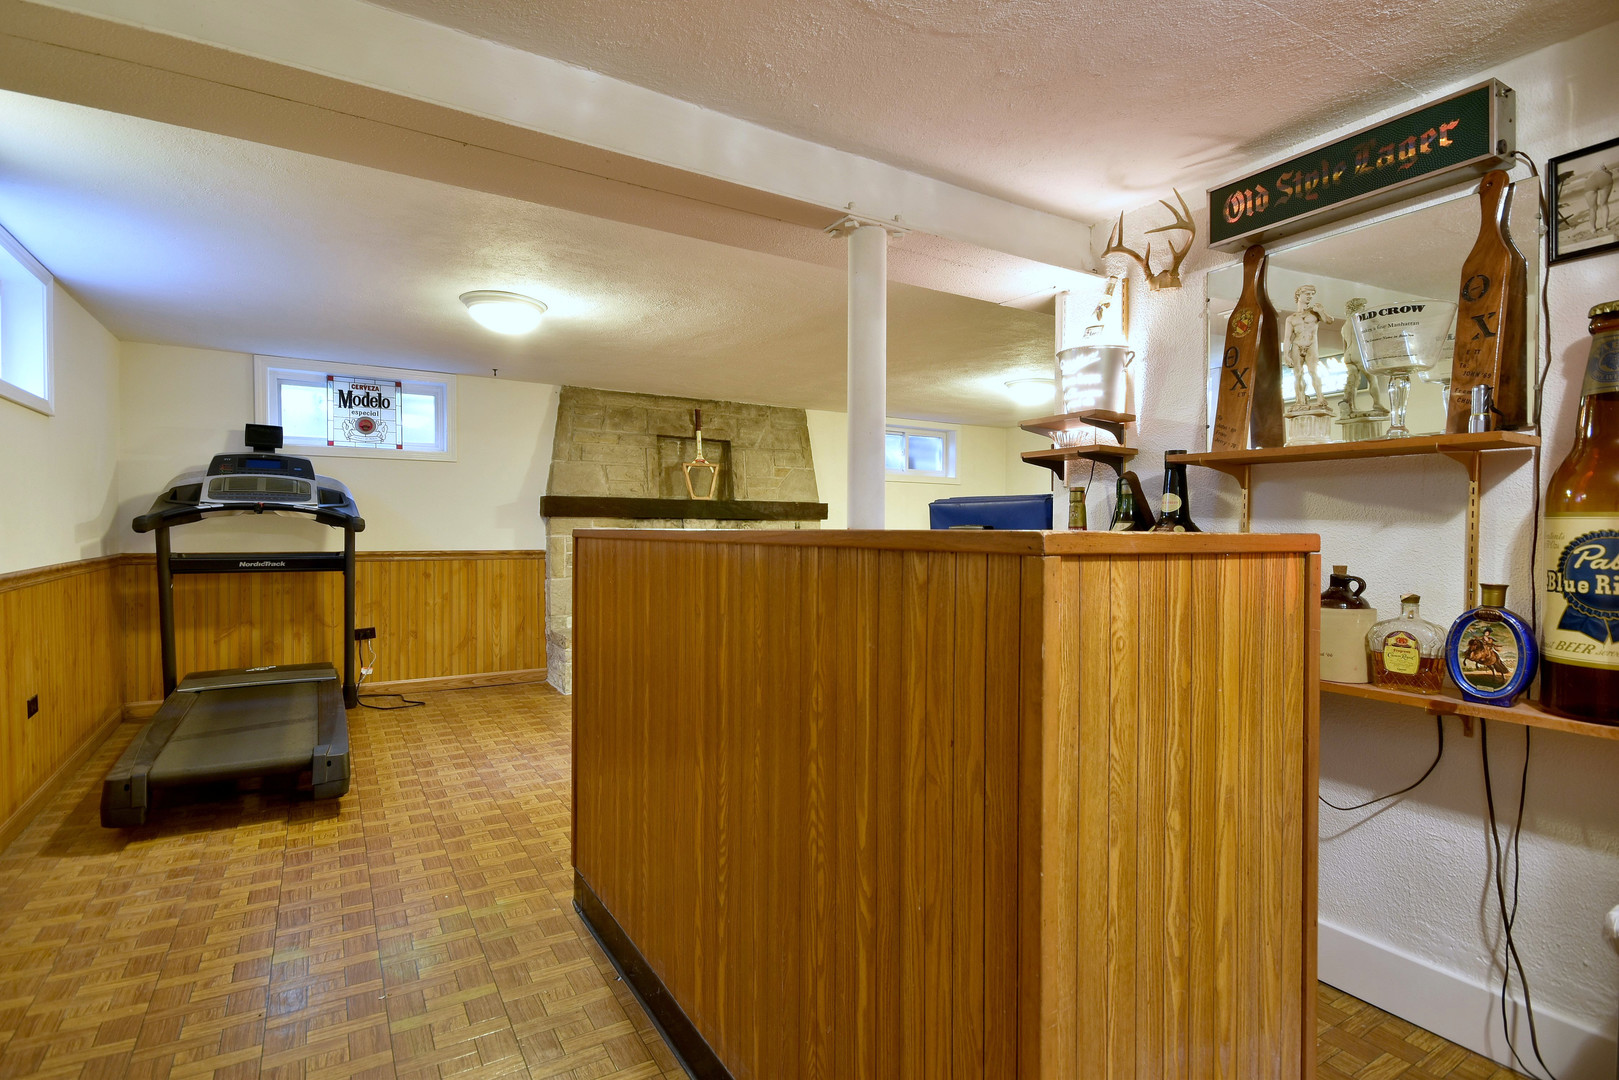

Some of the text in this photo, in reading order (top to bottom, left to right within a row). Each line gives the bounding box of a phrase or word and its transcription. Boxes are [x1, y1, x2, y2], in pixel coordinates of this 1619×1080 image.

[1223, 118, 1460, 224] Old Style Lager
[1378, 304, 1426, 317] CROW
[351, 383, 380, 392] CERVEZA
[338, 388, 391, 409] Modelo
[1547, 570, 1590, 595] Blue
[1555, 640, 1597, 655] BEER
